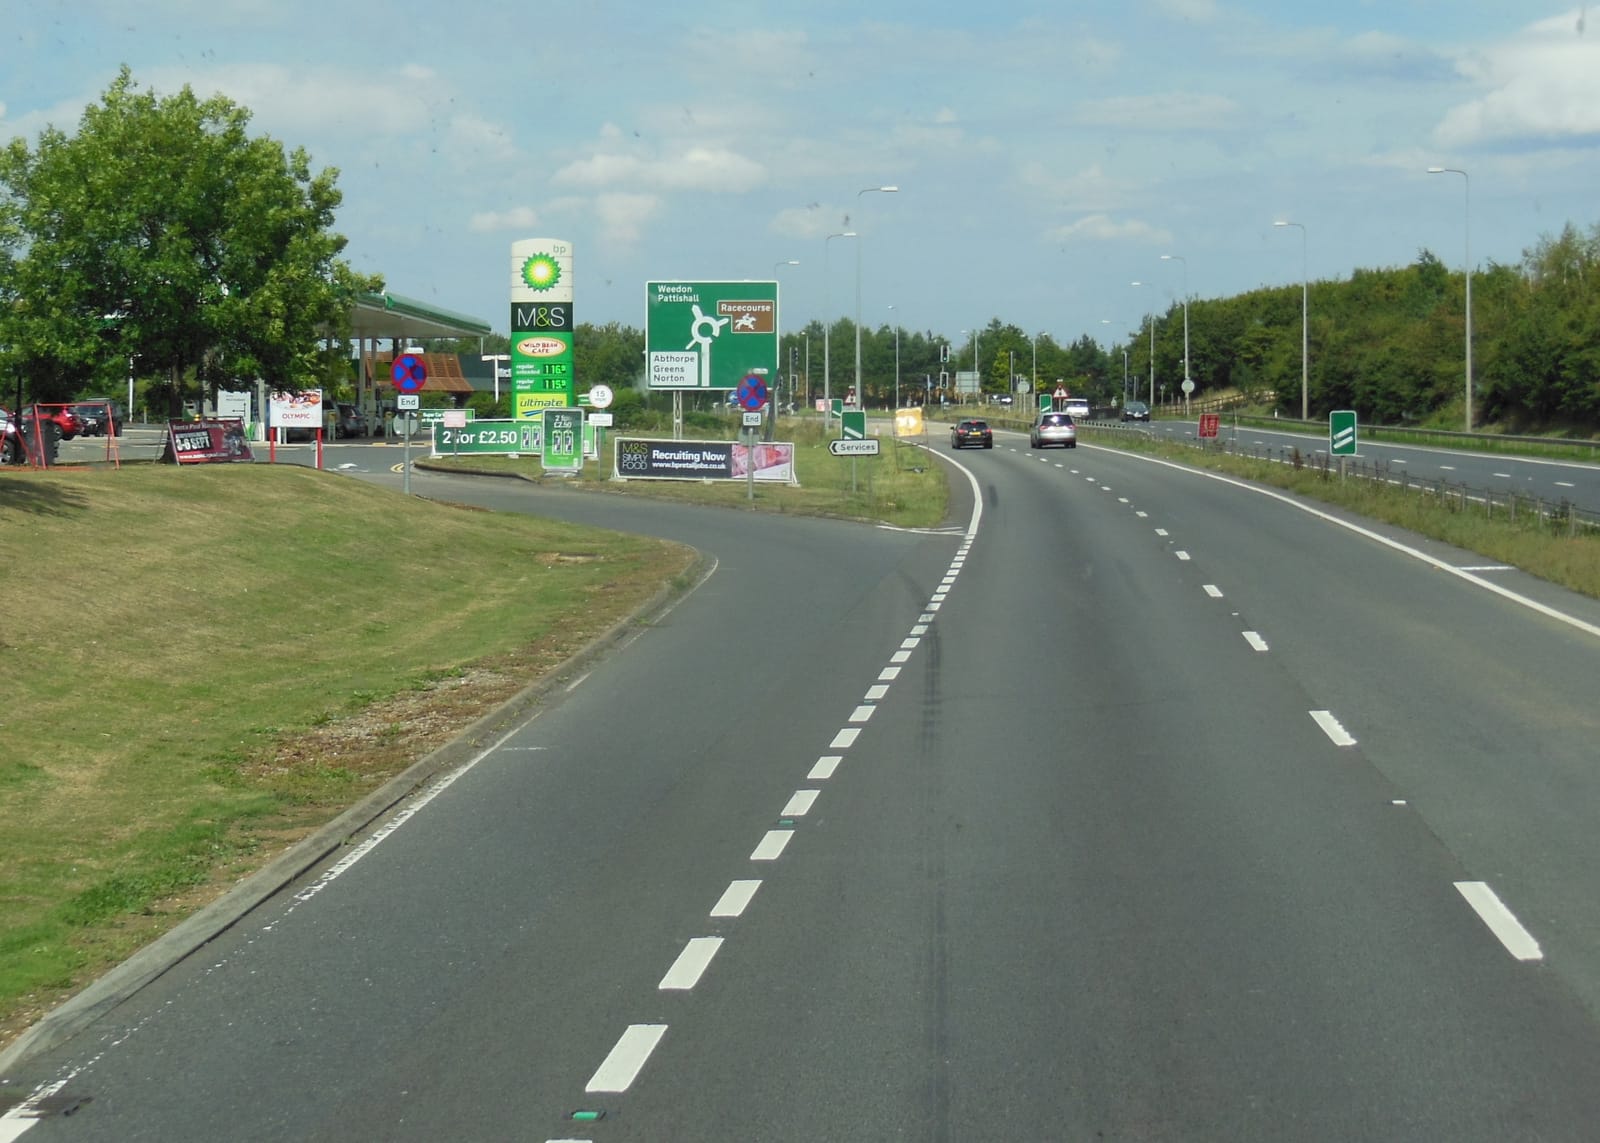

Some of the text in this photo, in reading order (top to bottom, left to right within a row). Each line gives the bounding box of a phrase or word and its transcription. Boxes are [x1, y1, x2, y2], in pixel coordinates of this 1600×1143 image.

[553, 245, 566, 255] bp
[658, 285, 692, 293] Weedon
[658, 294, 699, 302] Pattishall
[721, 304, 771, 312] Racecourse
[517, 307, 565, 326] M&S
[653, 355, 695, 364] Abthorpe
[520, 399, 563, 407] ultimate
[745, 415, 760, 423] End
[442, 431, 452, 444] 2
[479, 430, 517, 444] £2.50
[191, 436, 210, 449] SEPT
[622, 443, 648, 454] M&S
[652, 450, 726, 462] Recruiting Now
[622, 461, 648, 470] FOOD
